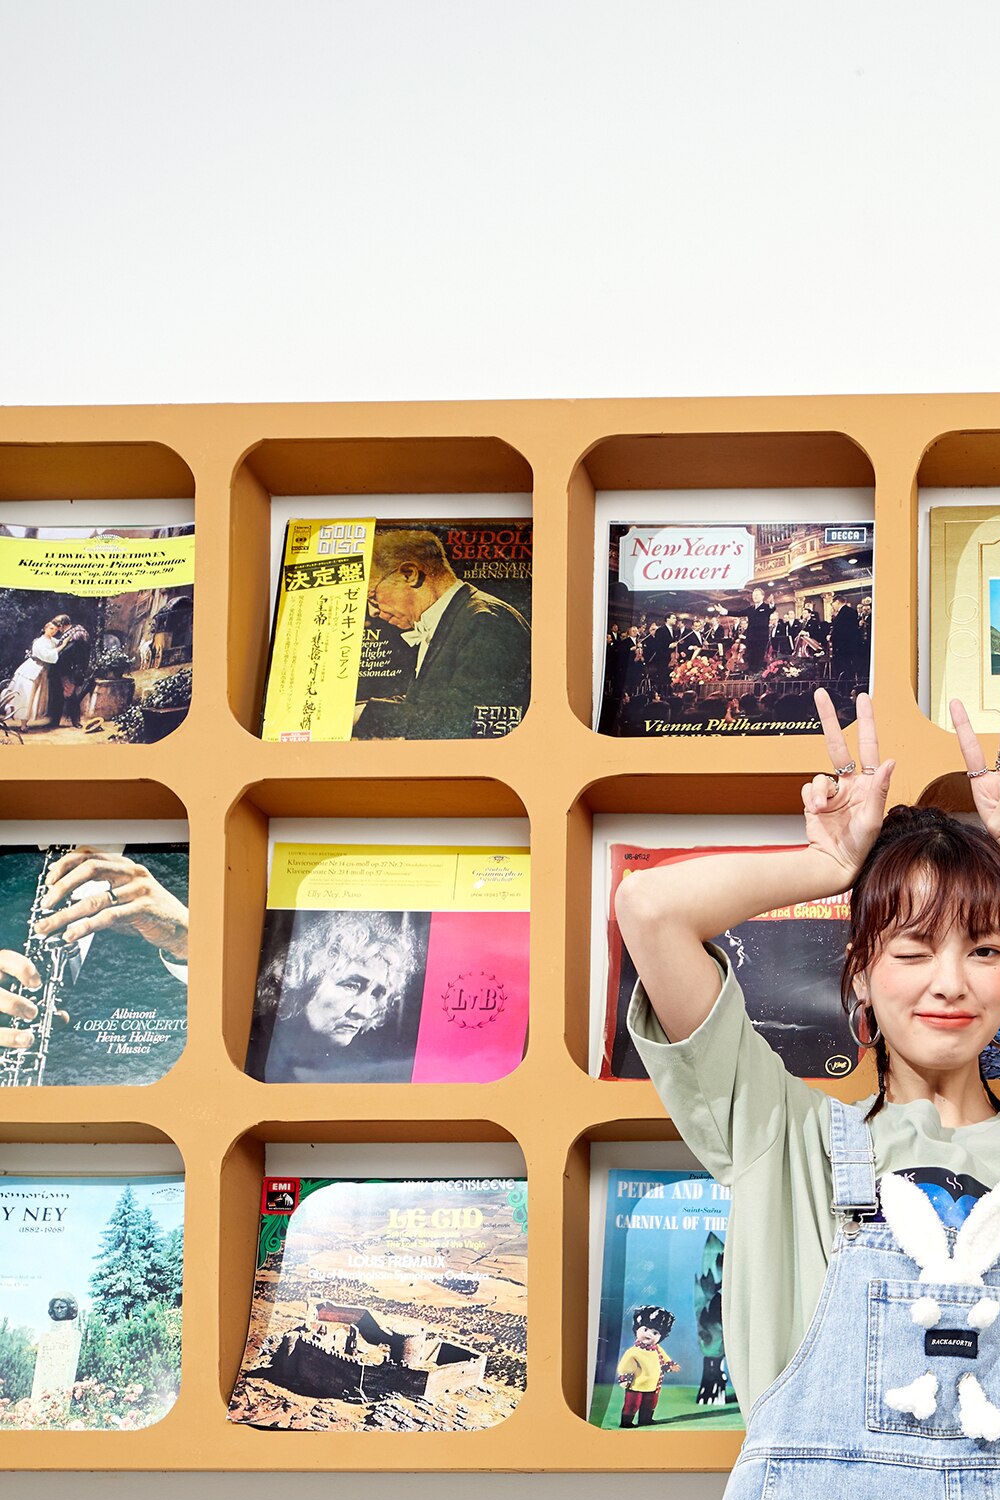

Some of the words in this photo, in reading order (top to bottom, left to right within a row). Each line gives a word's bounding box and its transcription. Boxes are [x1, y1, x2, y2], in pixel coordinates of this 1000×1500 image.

[831, 531, 860, 541] DECCA
[317, 540, 365, 555] DISC
[452, 545, 533, 560] SERKIN
[630, 537, 682, 557] New
[682, 537, 744, 557] Year's
[108, 551, 166, 559] BEETHOVEN
[110, 560, 142, 569] Piano
[144, 557, 187, 568] Sonatas
[642, 559, 731, 581] Concert
[286, 562, 364, 591] 決定盤
[463, 570, 533, 579] BERNSTEIN
[644, 720, 702, 732] Vienna
[705, 717, 821, 731] Philharmonic
[287, 859, 328, 867] Klaviersonate
[771, 907, 790, 918] and
[794, 904, 832, 919] GRADY
[451, 988, 497, 1011] LvB
[110, 1008, 157, 1019] Albinoni
[73, 1020, 81, 1031] 4
[83, 1019, 118, 1031] OBOE
[120, 1019, 188, 1031] CONCERTO
[95, 1031, 127, 1043] Heinz
[128, 1031, 172, 1046] Holliger
[106, 1043, 115, 1054] I
[115, 1043, 152, 1054] Musici
[272, 1183, 291, 1191] EMI
[430, 1178, 516, 1192] GREENSLEEVE
[617, 1181, 664, 1199] PETER
[671, 1182, 704, 1199] AND
[23, 1206, 68, 1222] NEY
[387, 1207, 427, 1230] LE
[615, 1213, 679, 1230] CARNIVAL
[682, 1216, 700, 1231] OF
[703, 1216, 728, 1231] THE
[464, 1240, 487, 1250] Virgin
[347, 1255, 384, 1268] LOUIS
[931, 1338, 973, 1348] BACK&FORTH
